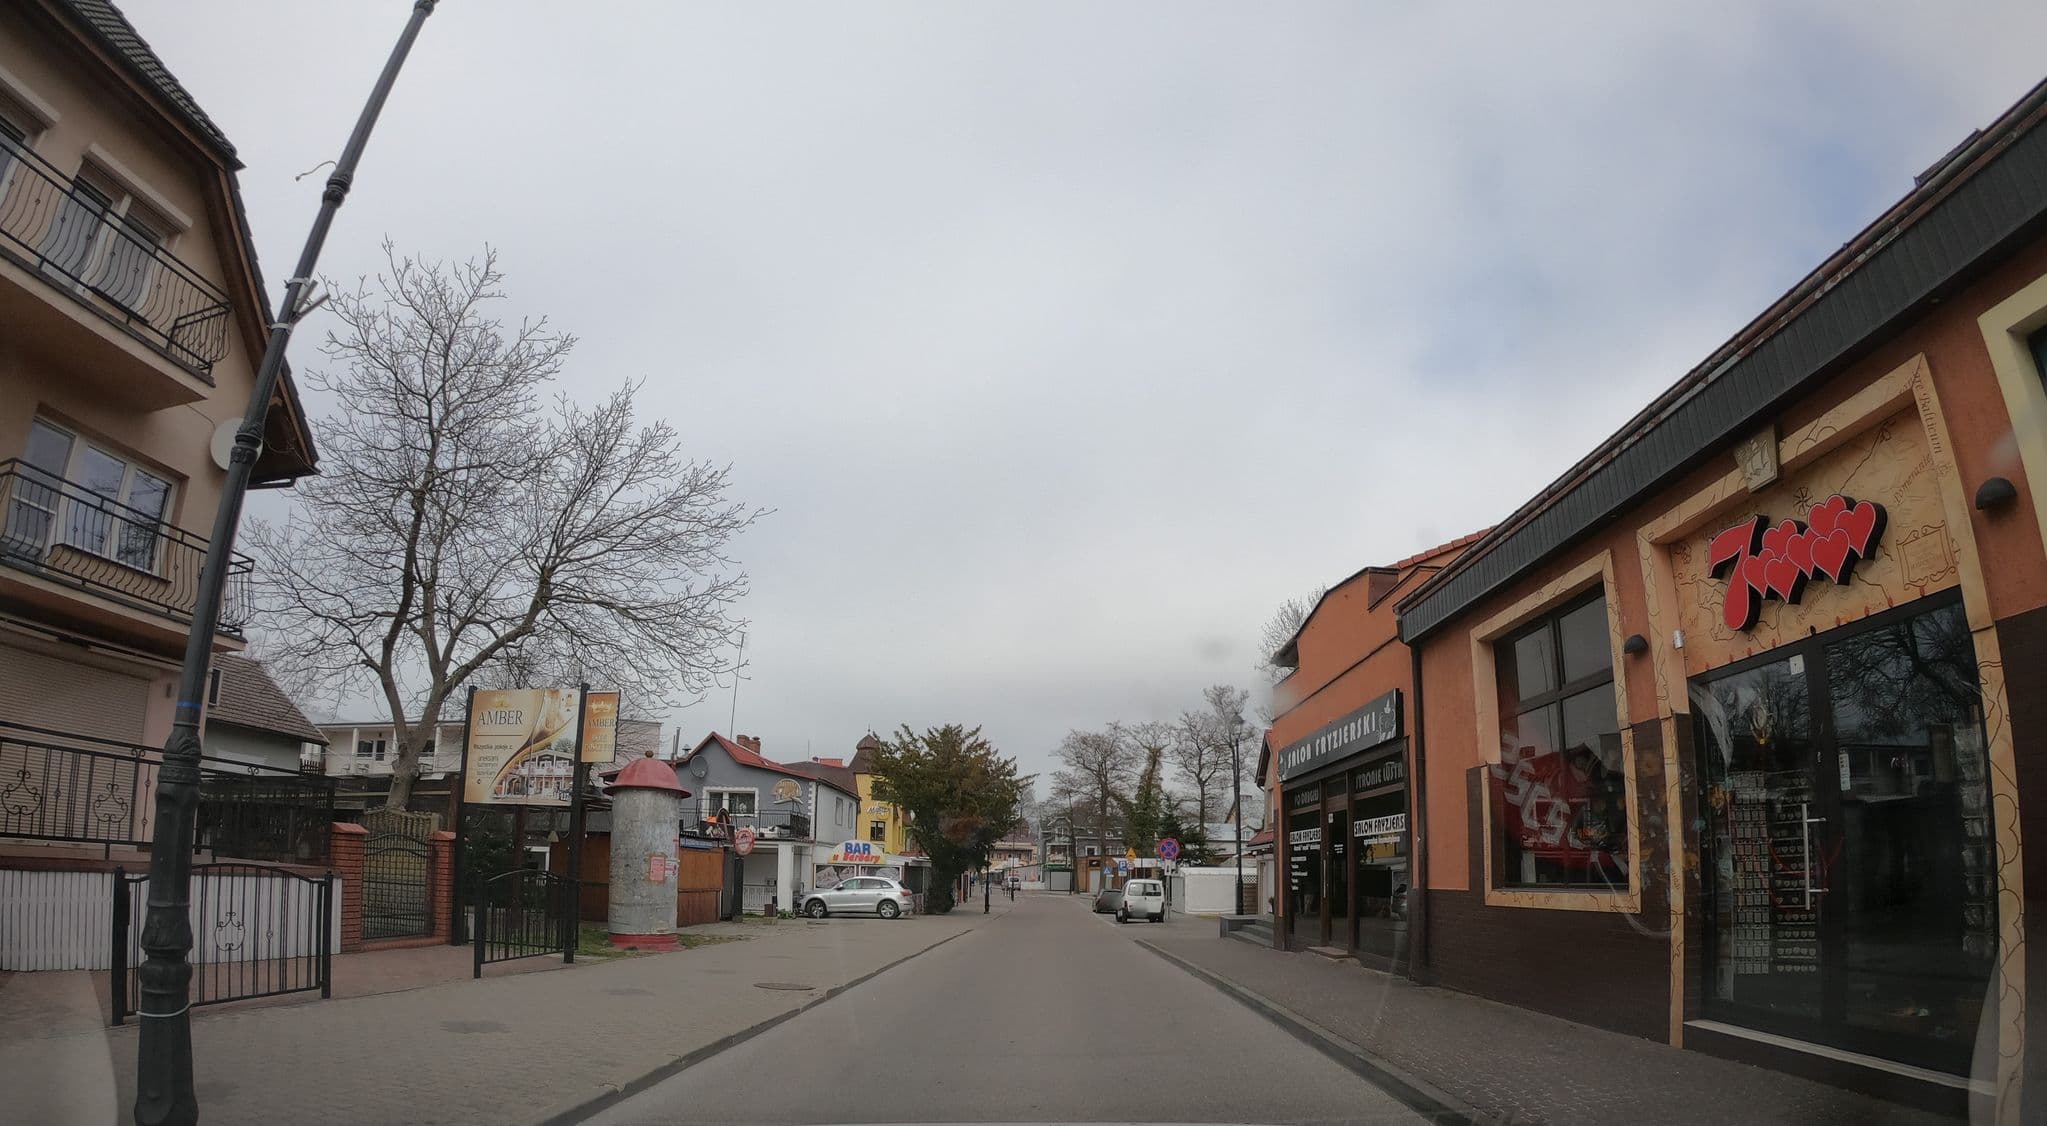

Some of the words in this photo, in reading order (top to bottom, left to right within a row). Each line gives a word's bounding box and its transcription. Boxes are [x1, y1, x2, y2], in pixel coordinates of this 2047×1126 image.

[478, 710, 523, 725] AMBER
[586, 718, 616, 728] AMBER
[1288, 743, 1312, 769] SALON
[1315, 711, 1376, 757] FRYZJERSKI
[1354, 820, 1373, 835] SALON
[844, 842, 870, 854] BAR
